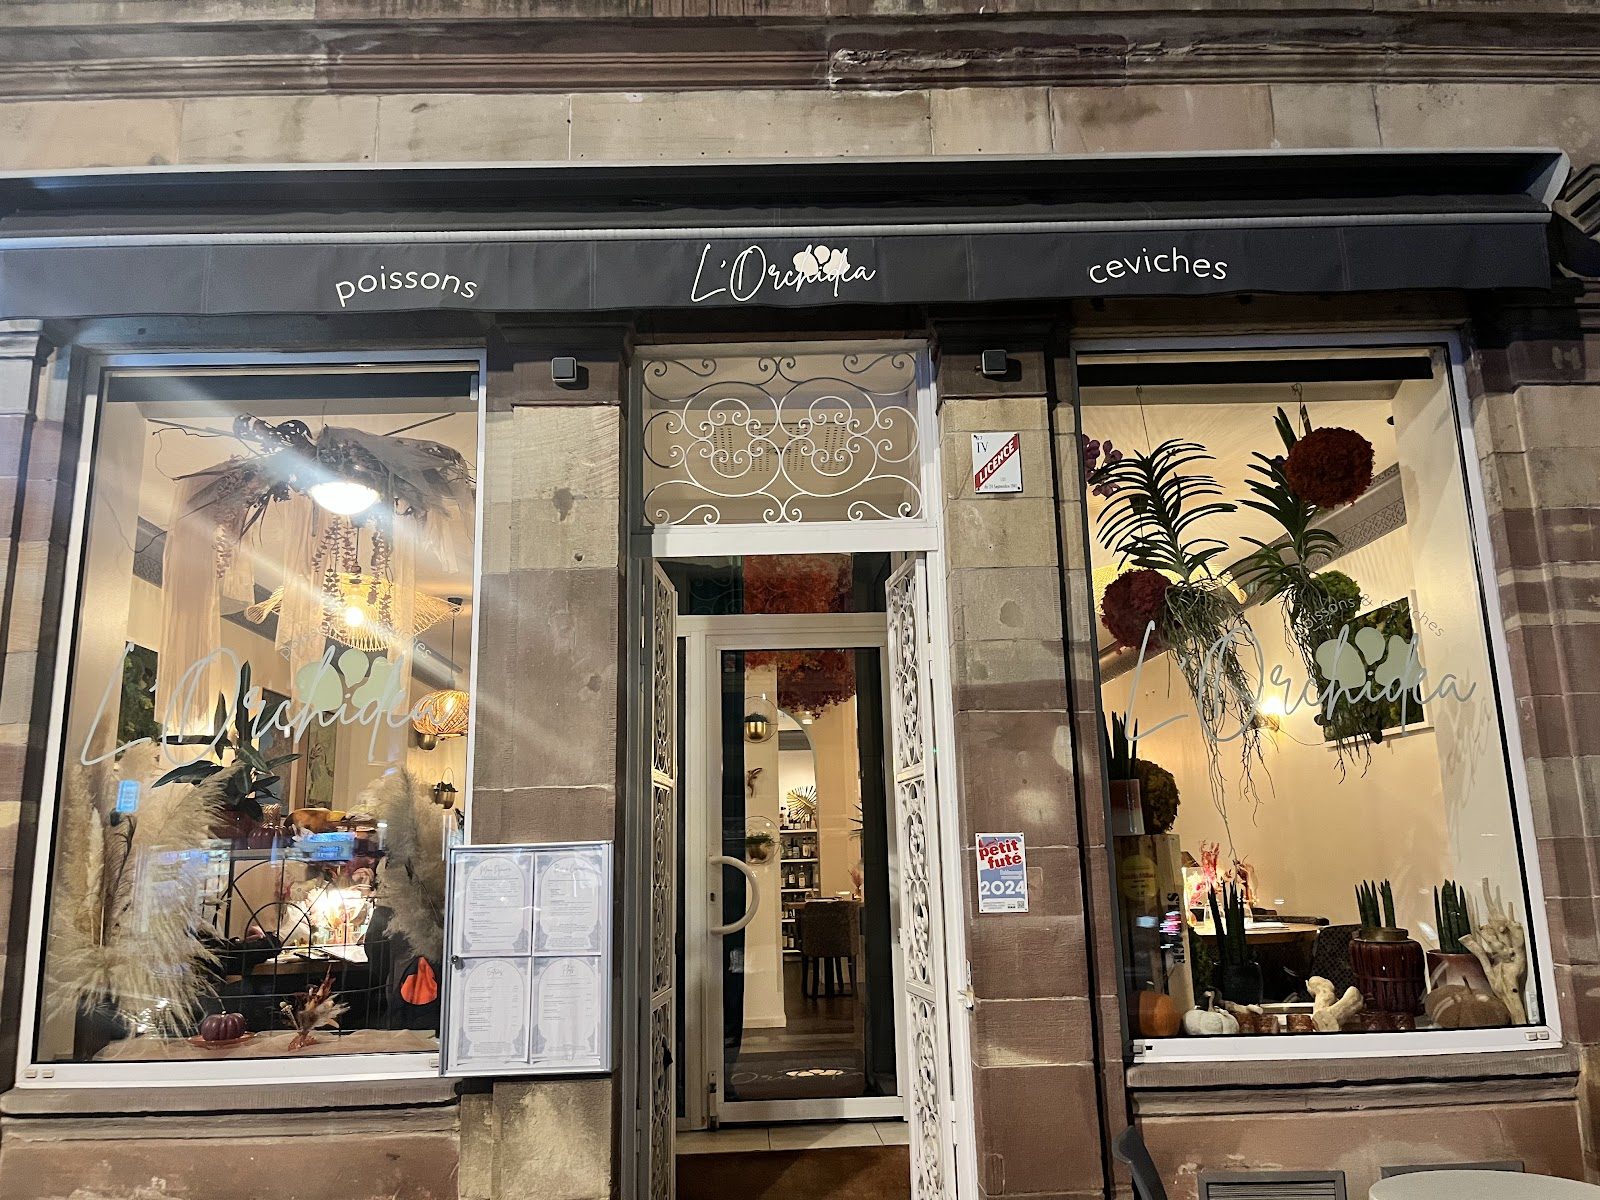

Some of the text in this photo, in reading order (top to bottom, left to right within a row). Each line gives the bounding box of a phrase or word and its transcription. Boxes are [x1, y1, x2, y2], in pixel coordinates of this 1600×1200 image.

[1088, 246, 1229, 284] ceviches
[335, 265, 478, 308] poissons
[979, 440, 1015, 484] LICENCE
[979, 839, 1019, 861] petit
[987, 852, 1022, 869] futé
[981, 880, 1026, 895] 2024
